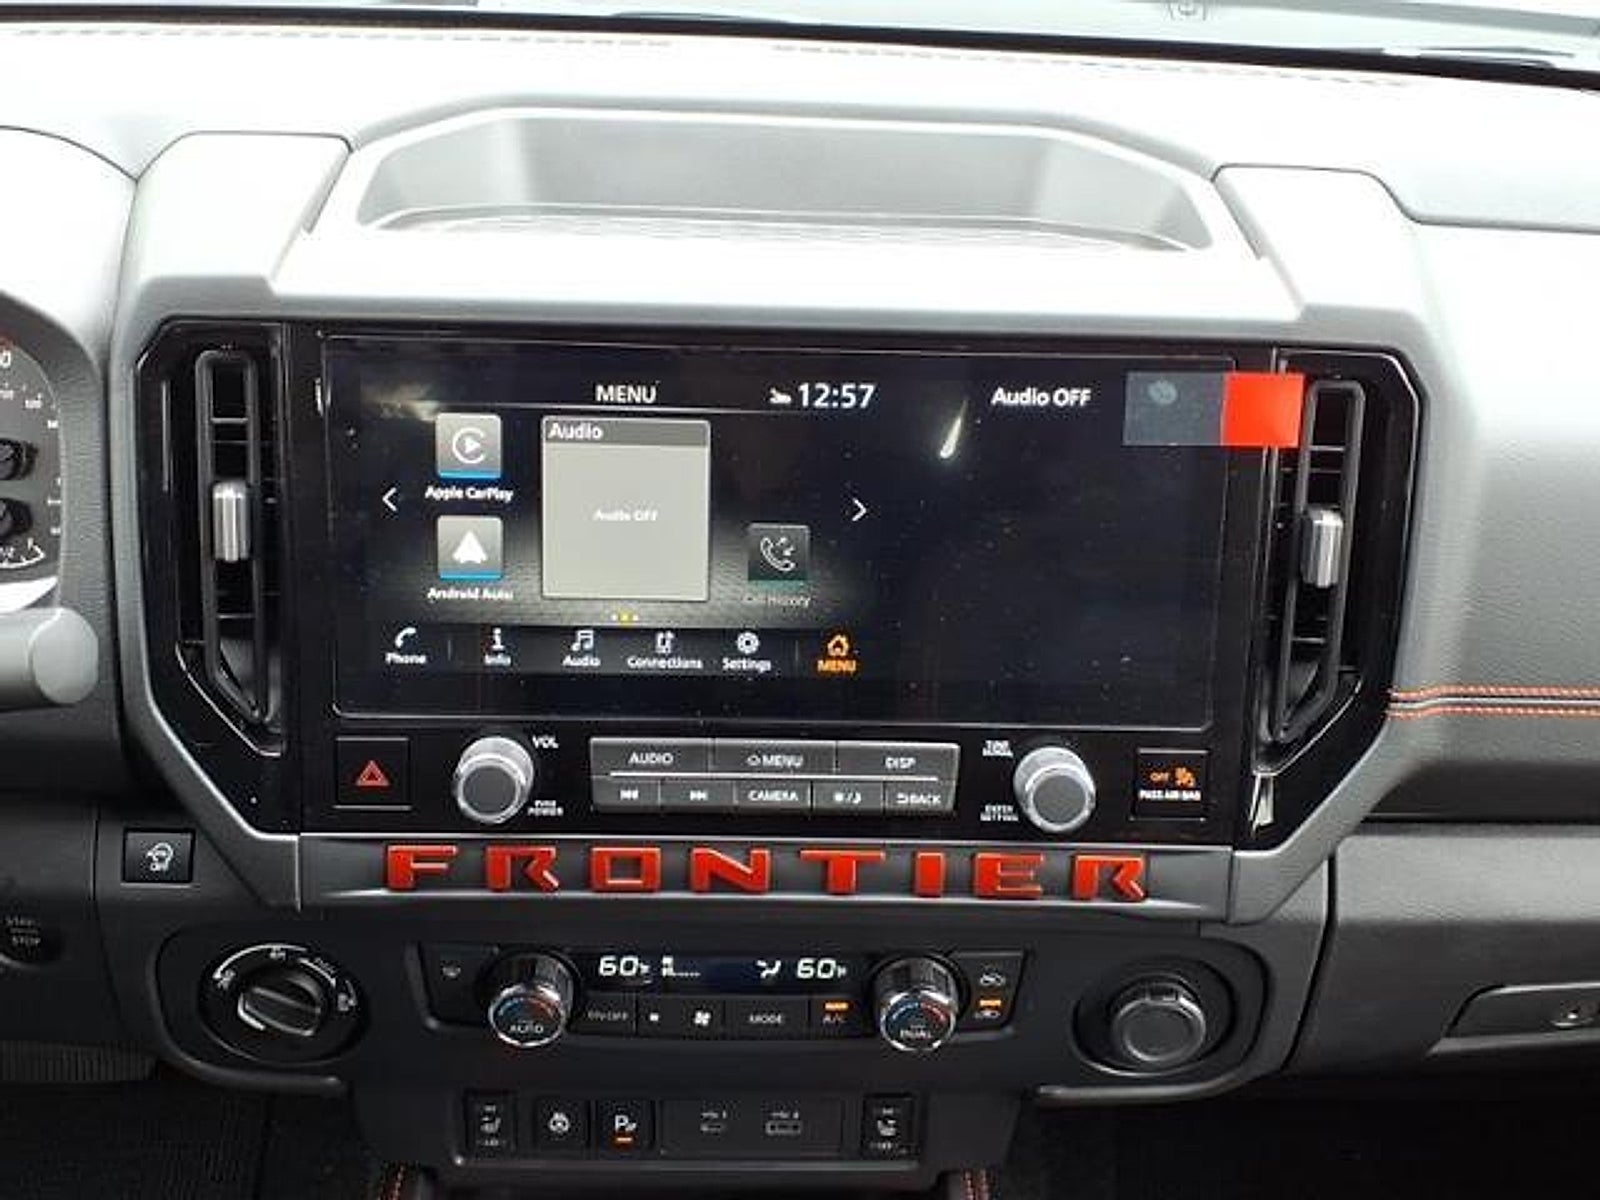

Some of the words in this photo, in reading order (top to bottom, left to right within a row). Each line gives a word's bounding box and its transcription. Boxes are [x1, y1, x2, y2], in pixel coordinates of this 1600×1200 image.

[595, 384, 657, 404] MENU
[798, 382, 876, 409] 12:57
[990, 386, 1049, 407] Audio
[1052, 387, 1093, 408] OFF
[548, 422, 603, 441] Audio
[424, 485, 464, 501] Apple
[466, 486, 515, 504] CarPlay
[427, 586, 479, 600] Android
[385, 652, 427, 665] Phone
[485, 652, 512, 666] Info
[562, 654, 601, 667] Audio
[626, 655, 704, 669] Connections
[722, 657, 772, 673] Settings
[817, 659, 857, 673] MENU
[532, 734, 559, 749] VOL
[628, 750, 674, 766] AUDIO
[762, 753, 804, 768] MENU
[884, 755, 917, 770] DISP
[748, 789, 799, 802] CAMERA
[385, 844, 1148, 903] FRONTIER
[749, 1012, 783, 1024] MODE
[510, 1023, 545, 1035] AUTO
